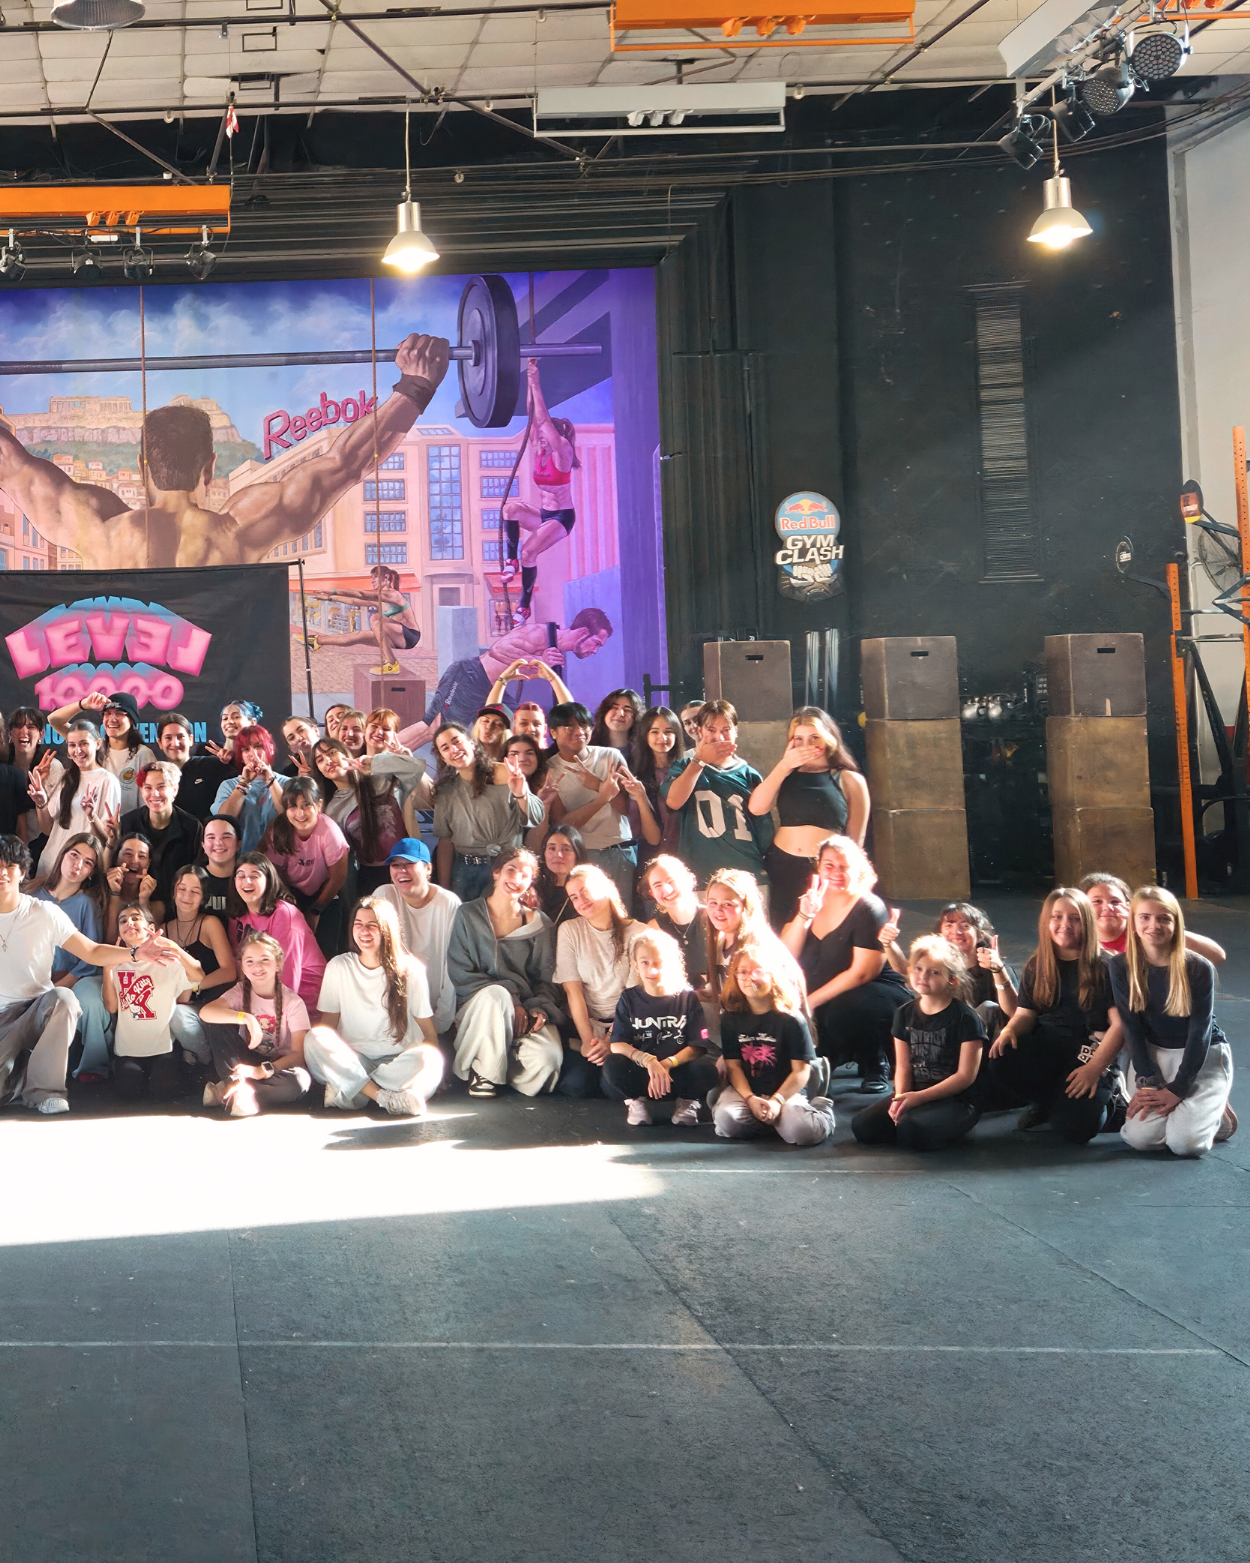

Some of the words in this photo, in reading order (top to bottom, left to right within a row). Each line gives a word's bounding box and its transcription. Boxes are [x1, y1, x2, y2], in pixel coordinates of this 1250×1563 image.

[263, 390, 379, 460] Reebok
[780, 516, 808, 530] Red
[809, 514, 836, 529] Bull
[786, 534, 835, 550] GYM
[775, 545, 844, 565] CLASH
[5, 600, 212, 680] LEVEL
[34, 668, 184, 711] 10000
[694, 789, 753, 842] 01
